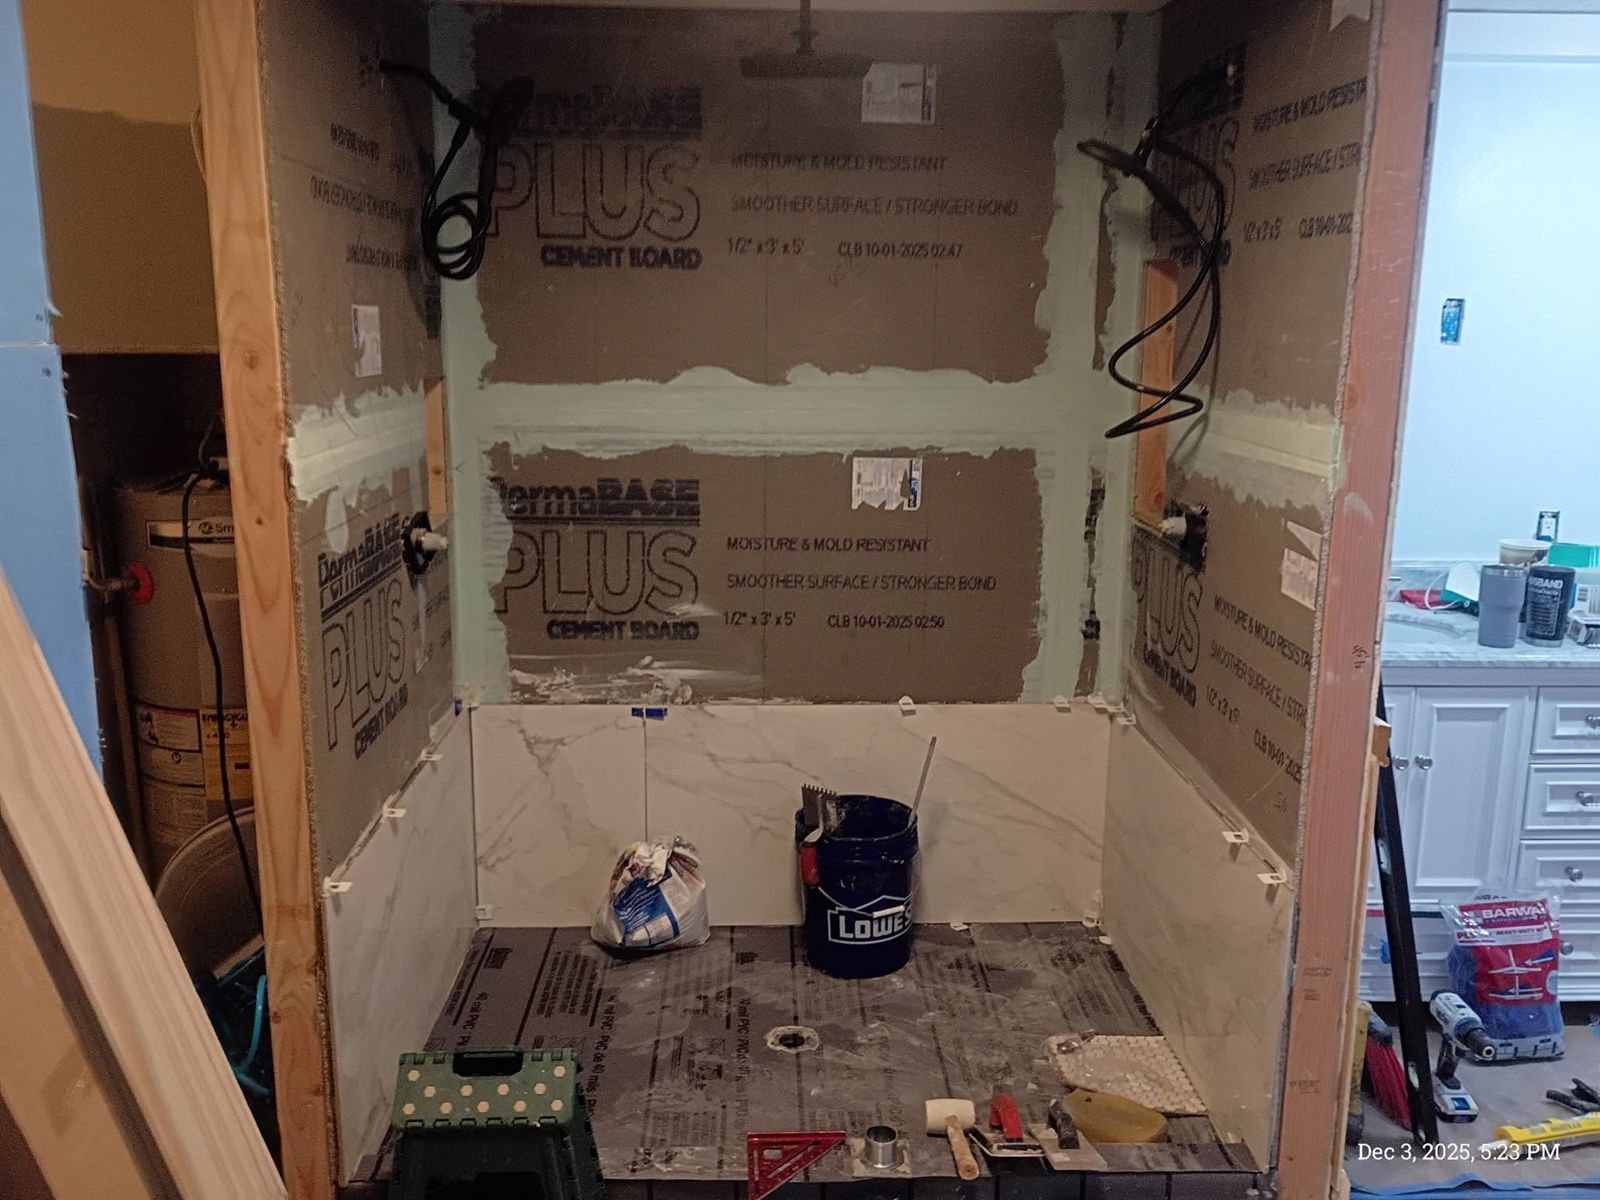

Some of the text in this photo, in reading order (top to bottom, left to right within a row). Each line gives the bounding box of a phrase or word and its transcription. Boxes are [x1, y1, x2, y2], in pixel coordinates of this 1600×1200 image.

[822, 154, 863, 171] MOLD
[868, 155, 947, 172] RESISTANT
[486, 142, 702, 242] PLUS
[731, 195, 812, 214] SMOOTHER
[814, 196, 882, 214] SURFACE
[894, 197, 974, 215] STRONGER
[976, 198, 1020, 216] BOND
[541, 244, 703, 269] CEMENT BOARD
[838, 242, 861, 258] CLB
[726, 536, 932, 554] MOISTURE & MOLD RESISTANT
[494, 530, 700, 615] PLUS
[726, 574, 997, 593] SMOOTHER SURFACE / STRONGER BOND
[547, 620, 700, 640] CEMENT BOARD
[723, 611, 748, 628] 1/2"
[751, 616, 758, 627] x
[775, 617, 783, 628] x
[828, 615, 850, 628] CLB
[853, 615, 912, 629] 10-01-2025
[1252, 619, 1276, 649] MOLD
[321, 578, 406, 752] PLUS
